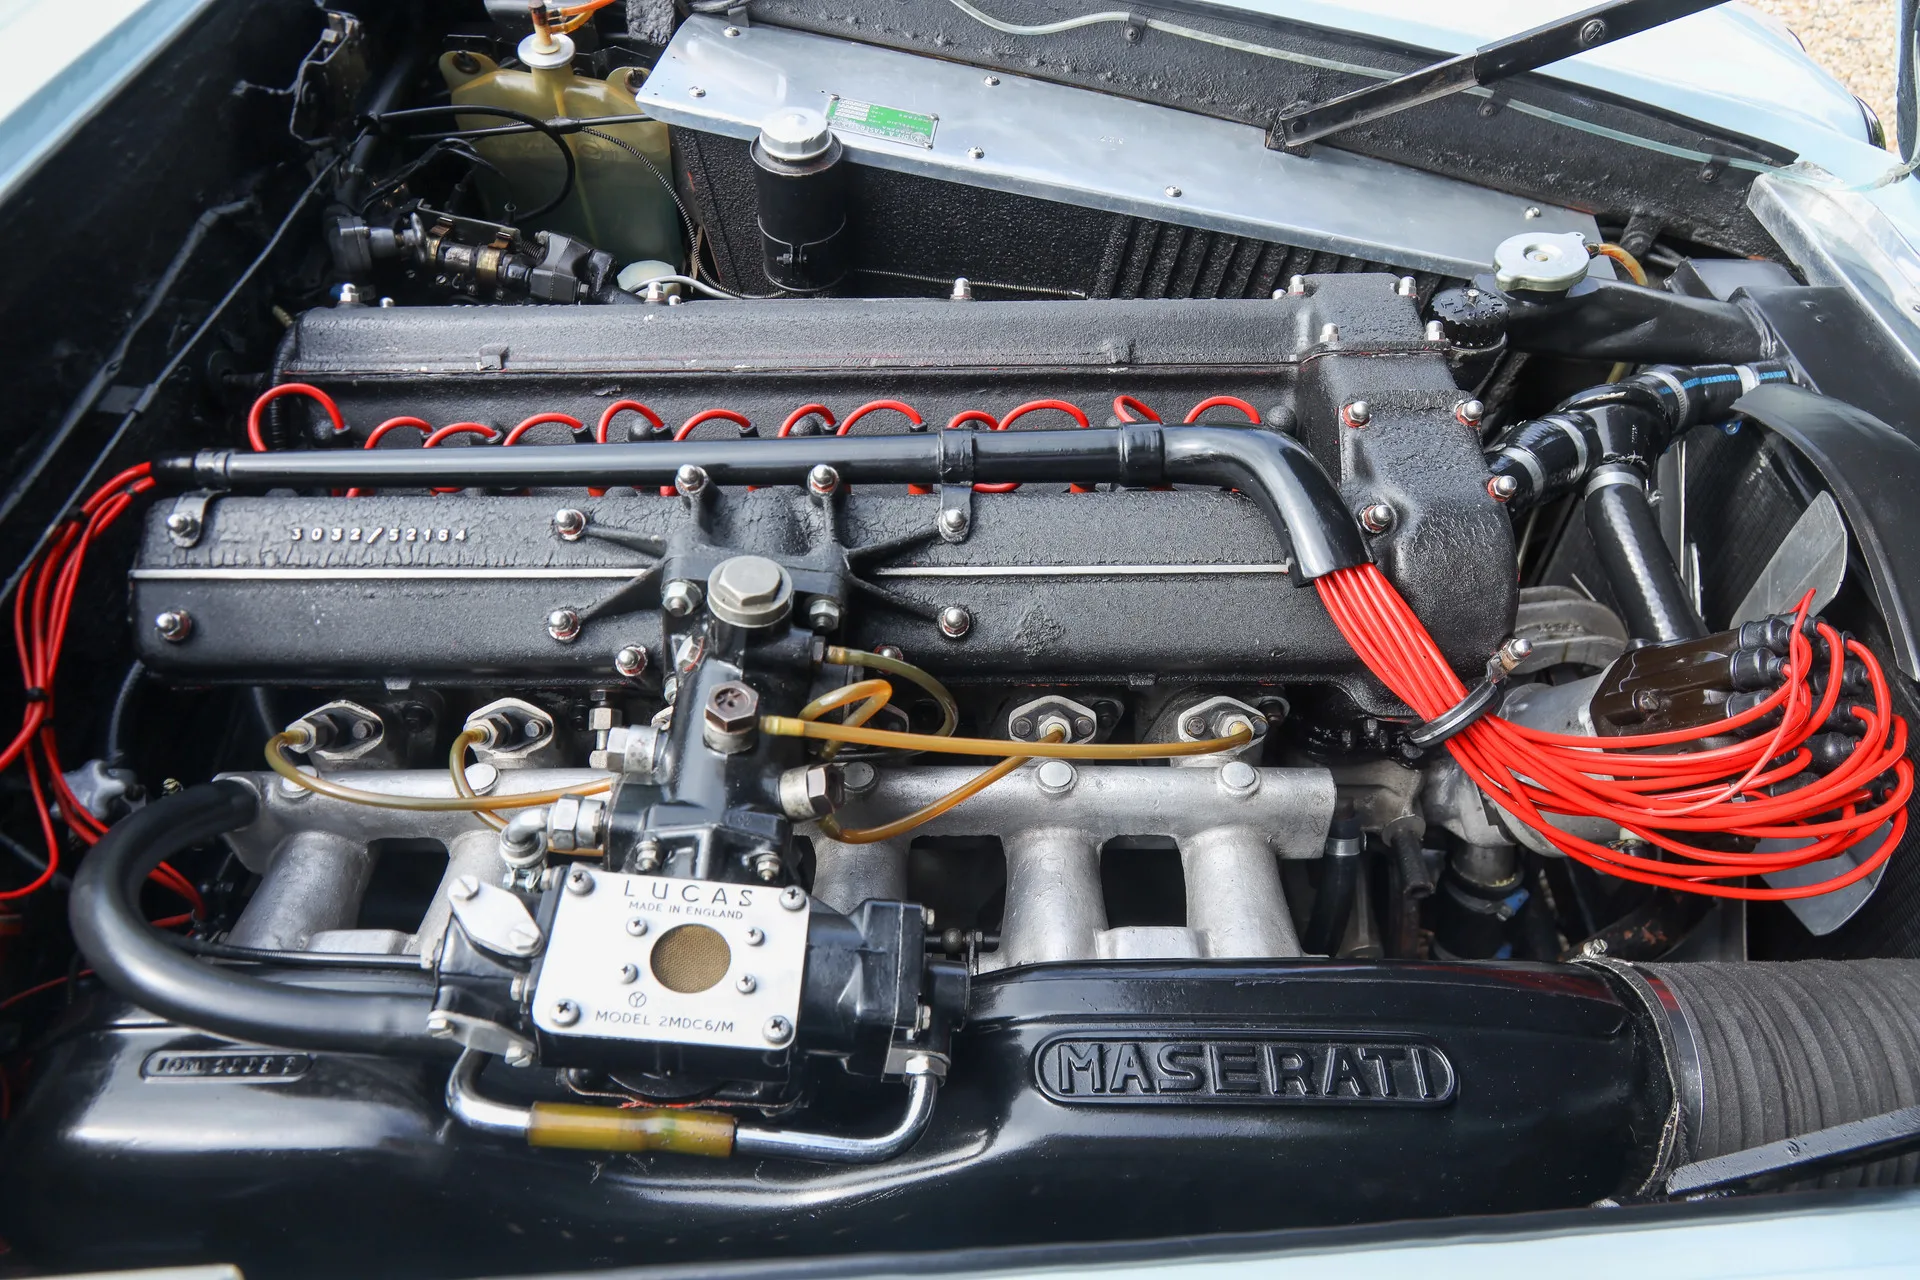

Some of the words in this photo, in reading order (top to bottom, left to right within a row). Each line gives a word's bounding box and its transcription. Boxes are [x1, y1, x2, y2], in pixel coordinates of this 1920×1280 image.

[291, 527, 467, 545] 3032/52164
[624, 880, 753, 907] LUCAS
[628, 901, 663, 913] MADE
[669, 905, 681, 914] IN
[686, 906, 744, 920] ENGLAND
[595, 1010, 651, 1026] MODEL
[659, 1016, 735, 1033] 2MDC6/M
[1058, 1044, 1436, 1099] MASERATI
